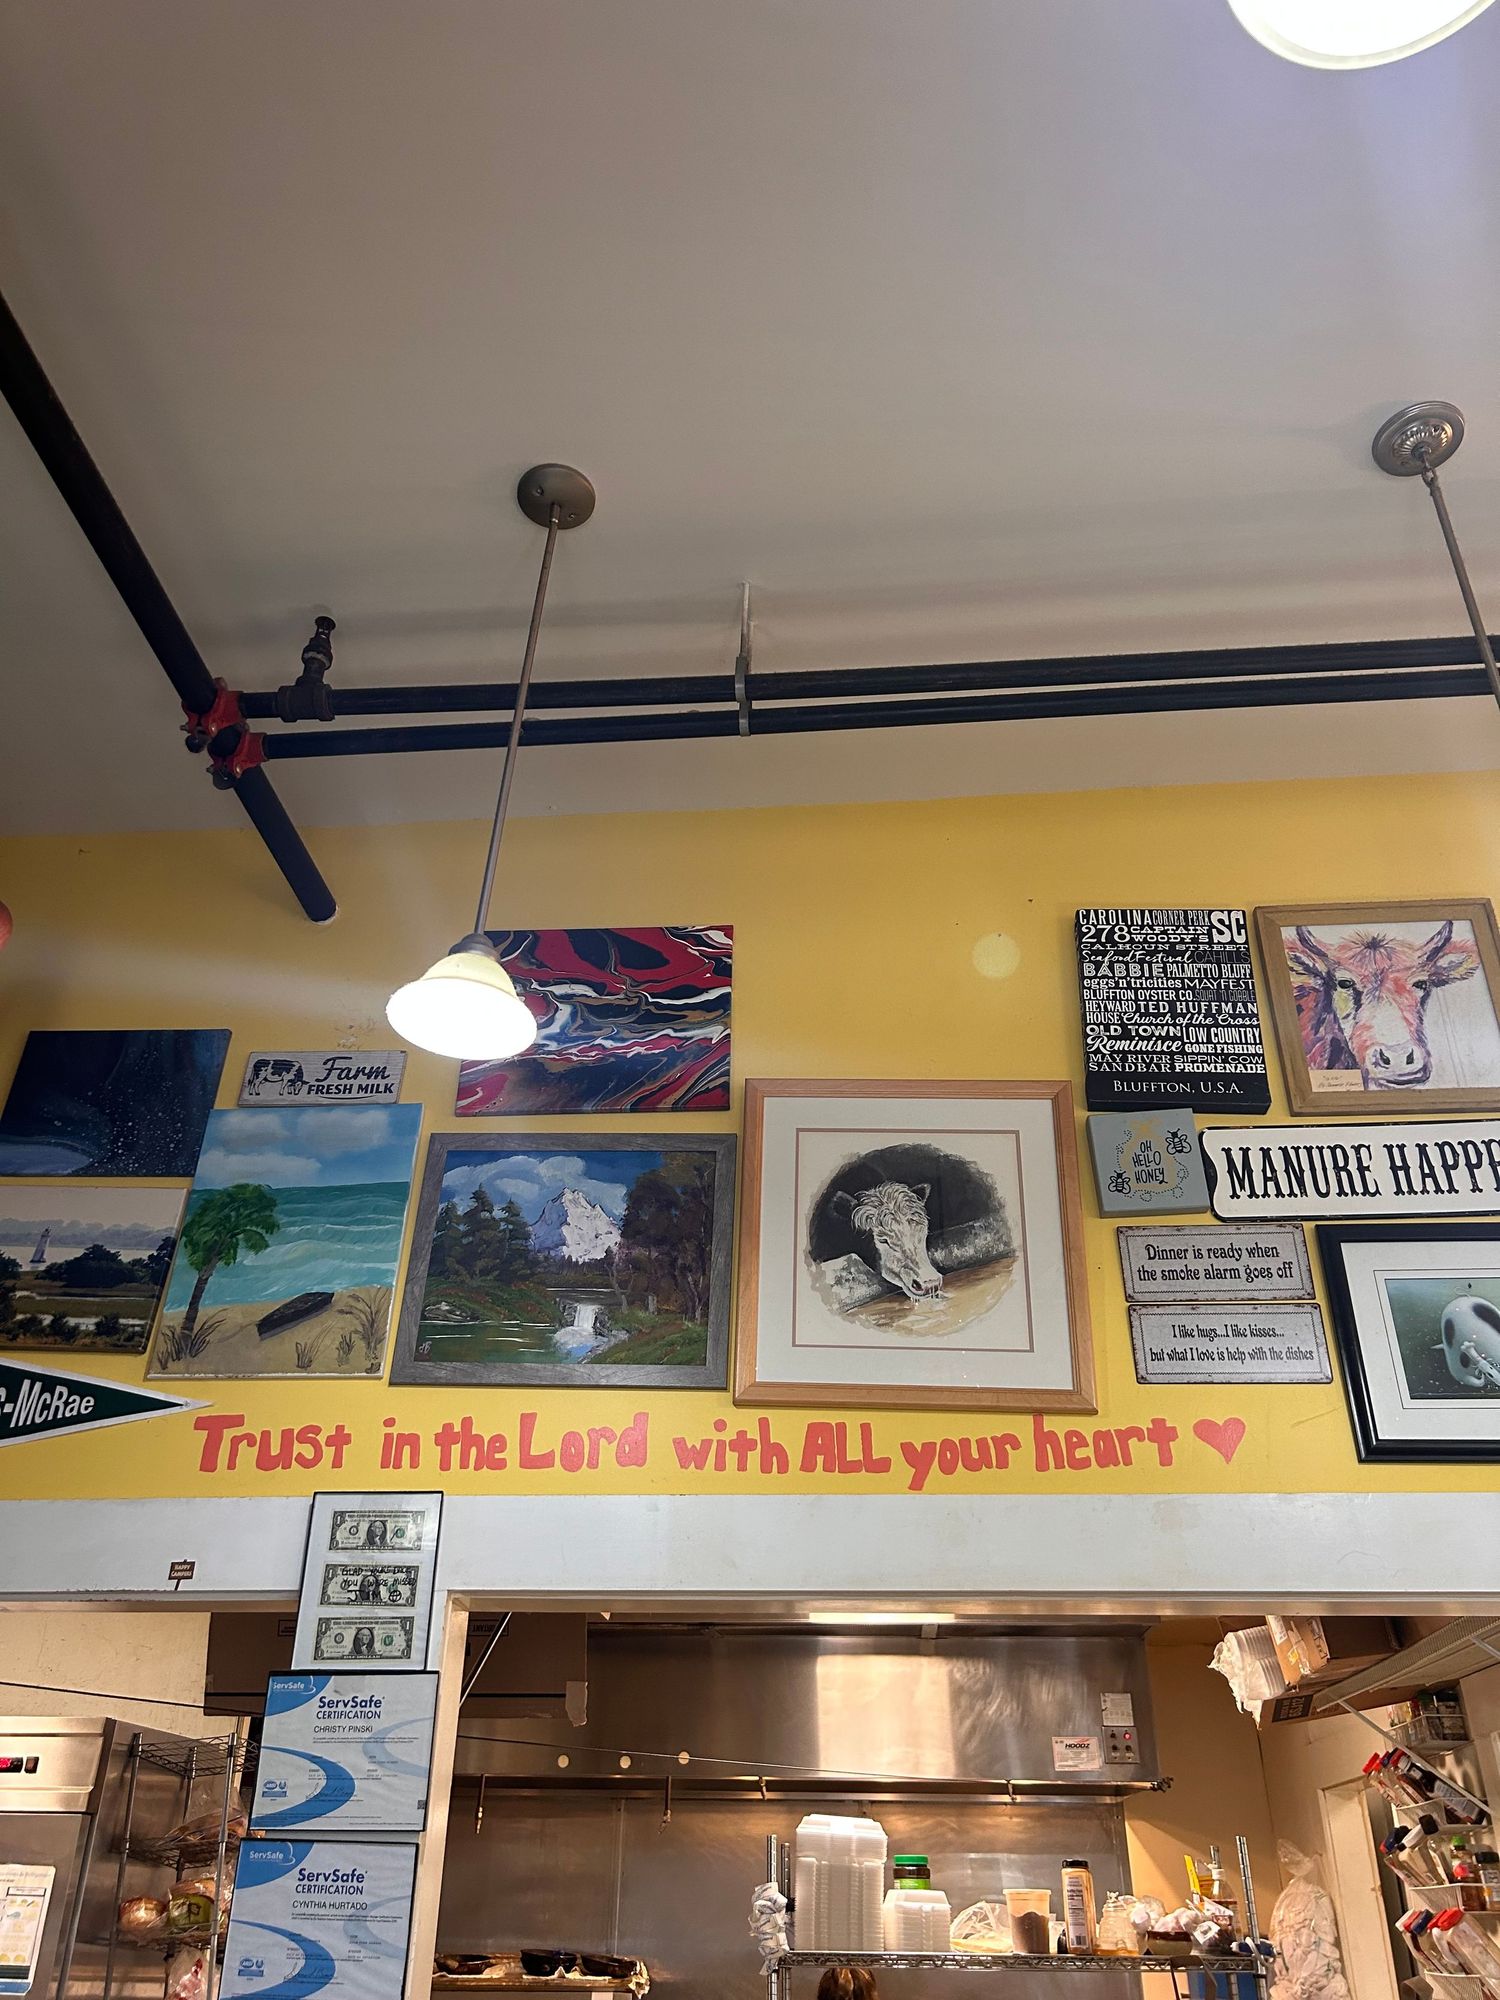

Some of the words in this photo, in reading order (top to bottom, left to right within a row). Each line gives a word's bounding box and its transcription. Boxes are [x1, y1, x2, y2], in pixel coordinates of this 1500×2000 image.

[1079, 909, 1152, 925] CAROLINA
[1152, 910, 1185, 925] CORNER
[1187, 910, 1210, 925] PERK
[1081, 925, 1130, 942] 278
[1130, 926, 1209, 934] CAPTAIN
[1210, 910, 1246, 943] SC
[1131, 934, 1209, 942] WOODY'S
[1082, 950, 1135, 966] Seafood
[1134, 950, 1193, 963] Festival
[1194, 951, 1250, 963] CAHILLS
[1083, 963, 1164, 977] BABBIE
[1167, 963, 1218, 978] PALMETTO
[1221, 963, 1251, 978] BLUFF
[1184, 979, 1255, 989] MAYFEST
[1083, 989, 1135, 1000] BLUFFTON
[1137, 990, 1176, 1000] OYSTER
[1179, 990, 1196, 1000] CO.
[1085, 1000, 1136, 1012] HEYWARD
[1138, 1001, 1169, 1013] TED
[1176, 1002, 1257, 1014] HUFFMAN
[1086, 1012, 1121, 1024] HOUSE
[1121, 1013, 1174, 1024] Church
[1176, 1013, 1191, 1026] of
[1192, 1014, 1215, 1024] the
[1216, 1013, 1260, 1025] Cross
[1086, 1025, 1122, 1035] OLD
[1127, 1025, 1181, 1036] TOWN
[1183, 1027, 1206, 1042] LOW
[1211, 1027, 1259, 1043] COUNTRY
[1087, 1035, 1182, 1054] Reminisce
[1184, 1044, 1215, 1053] GONE
[1216, 1044, 1263, 1054] FISHING
[1089, 1054, 1122, 1062] MAY
[1127, 1054, 1171, 1063] RIVER
[1174, 1055, 1225, 1063] SIPPIN'
[315, 1056, 390, 1082] Farm
[1089, 1062, 1171, 1072] SANDBAR
[1174, 1062, 1265, 1073] PROMENADE
[307, 1083, 352, 1095] FRESH
[356, 1083, 395, 1094] MILK
[1200, 1081, 1243, 1094] U.S.A.
[1140, 1140, 1152, 1153] OH
[1132, 1151, 1161, 1167] HELLO
[1135, 1168, 1168, 1184] HONEY
[1221, 1143, 1381, 1199] MANURE
[1145, 1243, 1189, 1261] Dinner
[1192, 1245, 1203, 1260] is
[1207, 1242, 1243, 1261] ready
[1246, 1242, 1280, 1258] when
[1137, 1265, 1157, 1281] the
[1161, 1264, 1200, 1281] smoke
[1204, 1263, 1241, 1280] alarm
[1244, 1264, 1273, 1283] goes
[1276, 1261, 1294, 1278] off
[1171, 1324, 1176, 1338] I
[1178, 1324, 1195, 1338] like
[1231, 1323, 1248, 1338] like
[1149, 1348, 1165, 1362] but
[1166, 1348, 1188, 1362] what
[1190, 1347, 1195, 1361] I
[1196, 1347, 1215, 1361] love
[1216, 1347, 1225, 1361] is
[1226, 1347, 1246, 1364] help
[1247, 1347, 1268, 1361] with
[1268, 1346, 1284, 1361] the
[1285, 1346, 1314, 1361] dishes
[193, 1413, 352, 1473] Trust
[380, 1417, 420, 1470] in
[434, 1416, 507, 1472] the
[518, 1412, 649, 1473] Lord
[672, 1416, 789, 1475] with
[799, 1421, 892, 1474] ALL
[900, 1433, 1022, 1491] your
[1032, 1414, 1179, 1473] heart
[318, 1695, 382, 1709] ServSafe
[316, 1710, 381, 1720] CERTIFICATION
[314, 1725, 347, 1734] CHRISTY
[348, 1725, 373, 1733] PINSKI
[249, 1850, 284, 1860] ServSafe
[297, 1868, 365, 1883] ServSafe
[295, 1884, 364, 1896] CERTIFICATION
[292, 1900, 327, 1910] CYNTHIA
[328, 1901, 368, 1911] HURTADO
